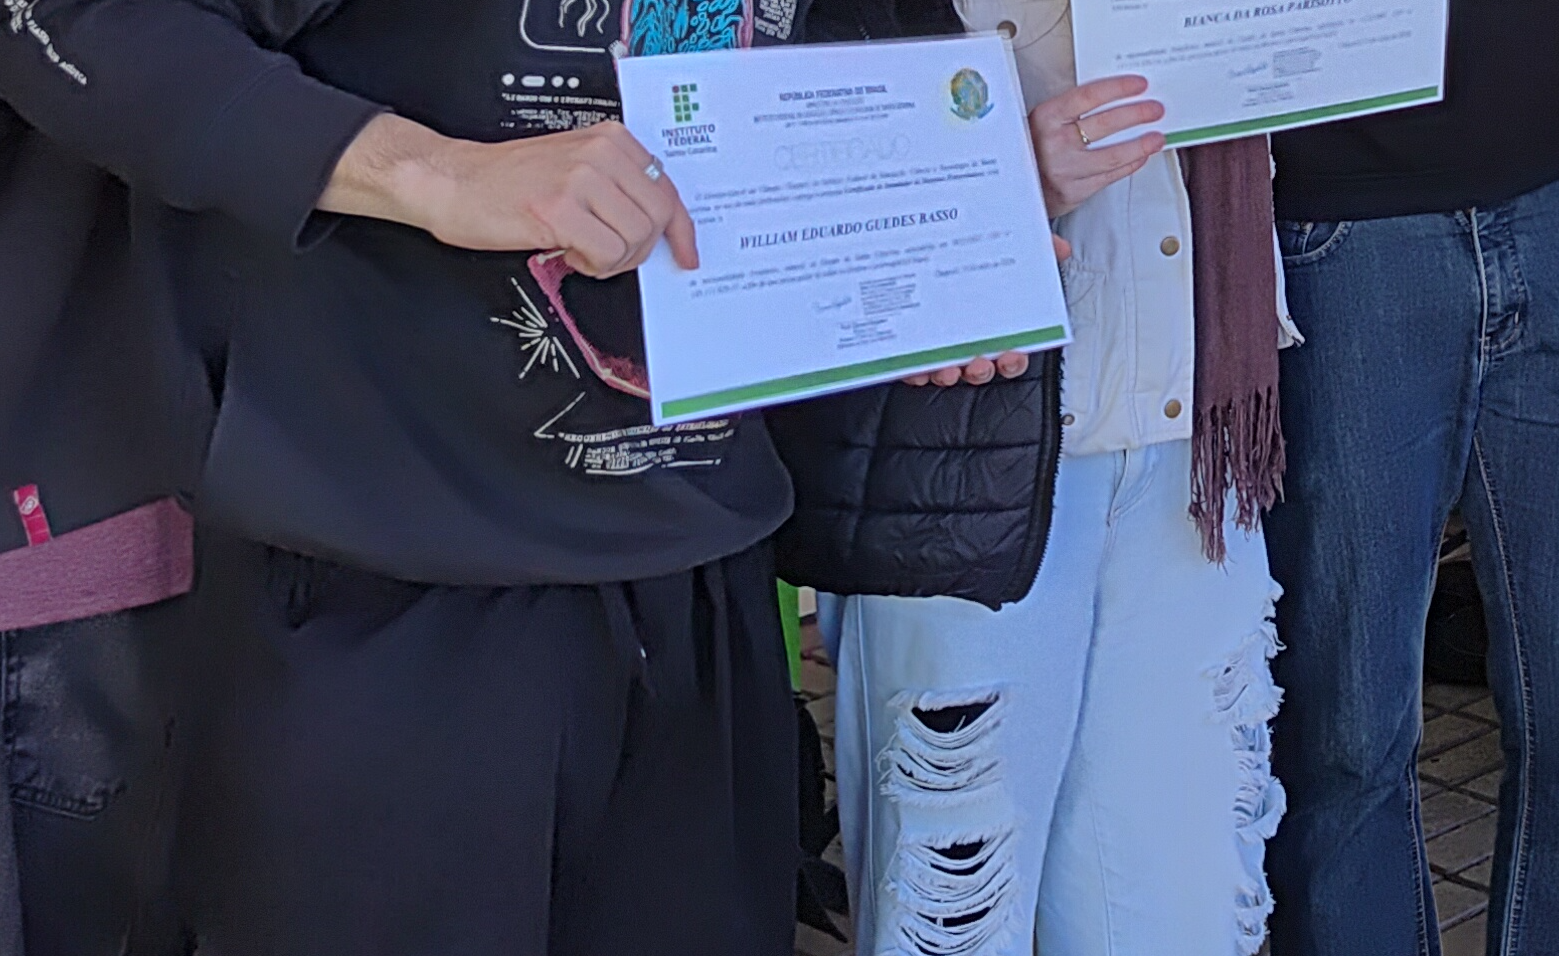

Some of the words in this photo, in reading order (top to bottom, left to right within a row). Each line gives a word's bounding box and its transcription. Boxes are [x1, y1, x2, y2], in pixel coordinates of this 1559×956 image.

[1184, 12, 1230, 27] BIANCA
[1233, 8, 1251, 21] DA
[1253, 5, 1284, 18] ROSA
[662, 123, 716, 137] INSTITUTO
[668, 134, 712, 147] FEDERAL
[740, 230, 798, 249] WILLIAM
[801, 222, 862, 241] EDUARDO
[865, 214, 916, 232] GUEDES
[919, 208, 959, 225] BASSO
